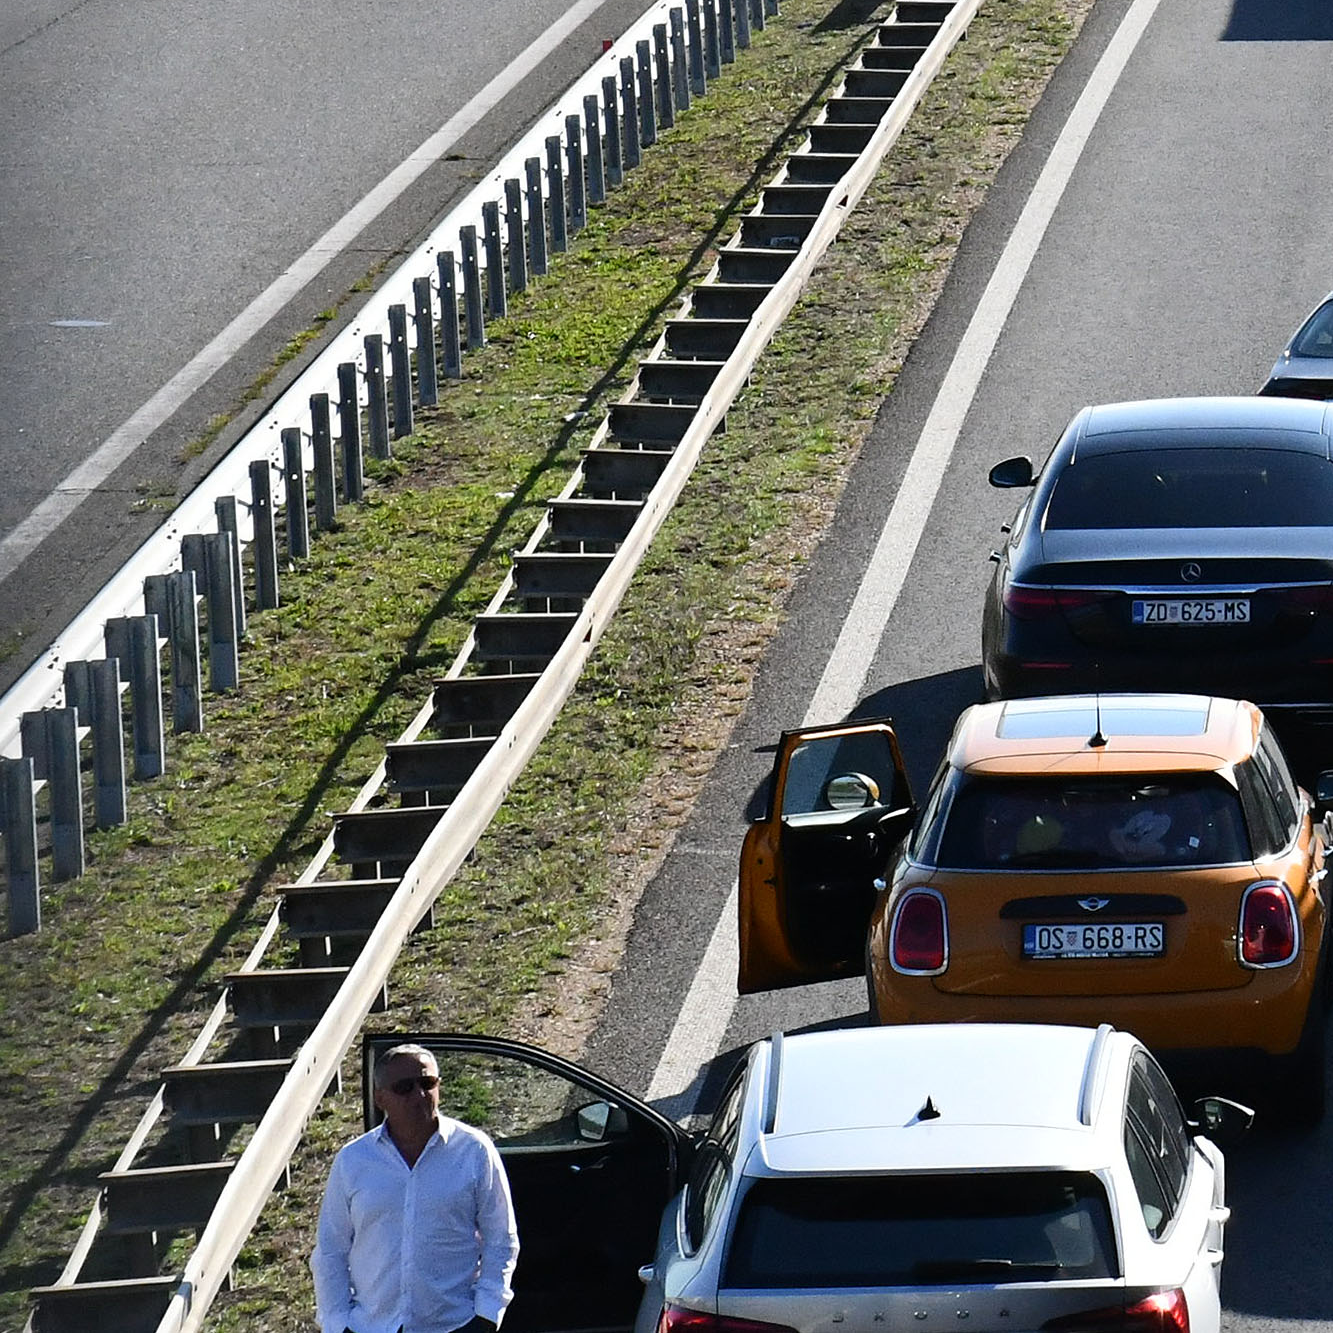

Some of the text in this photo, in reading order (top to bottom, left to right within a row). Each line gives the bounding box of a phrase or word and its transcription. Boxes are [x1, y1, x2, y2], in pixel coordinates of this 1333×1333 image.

[1145, 602, 1247, 621] ZD 625-MS
[1039, 926, 1161, 950] OS 668-RS
